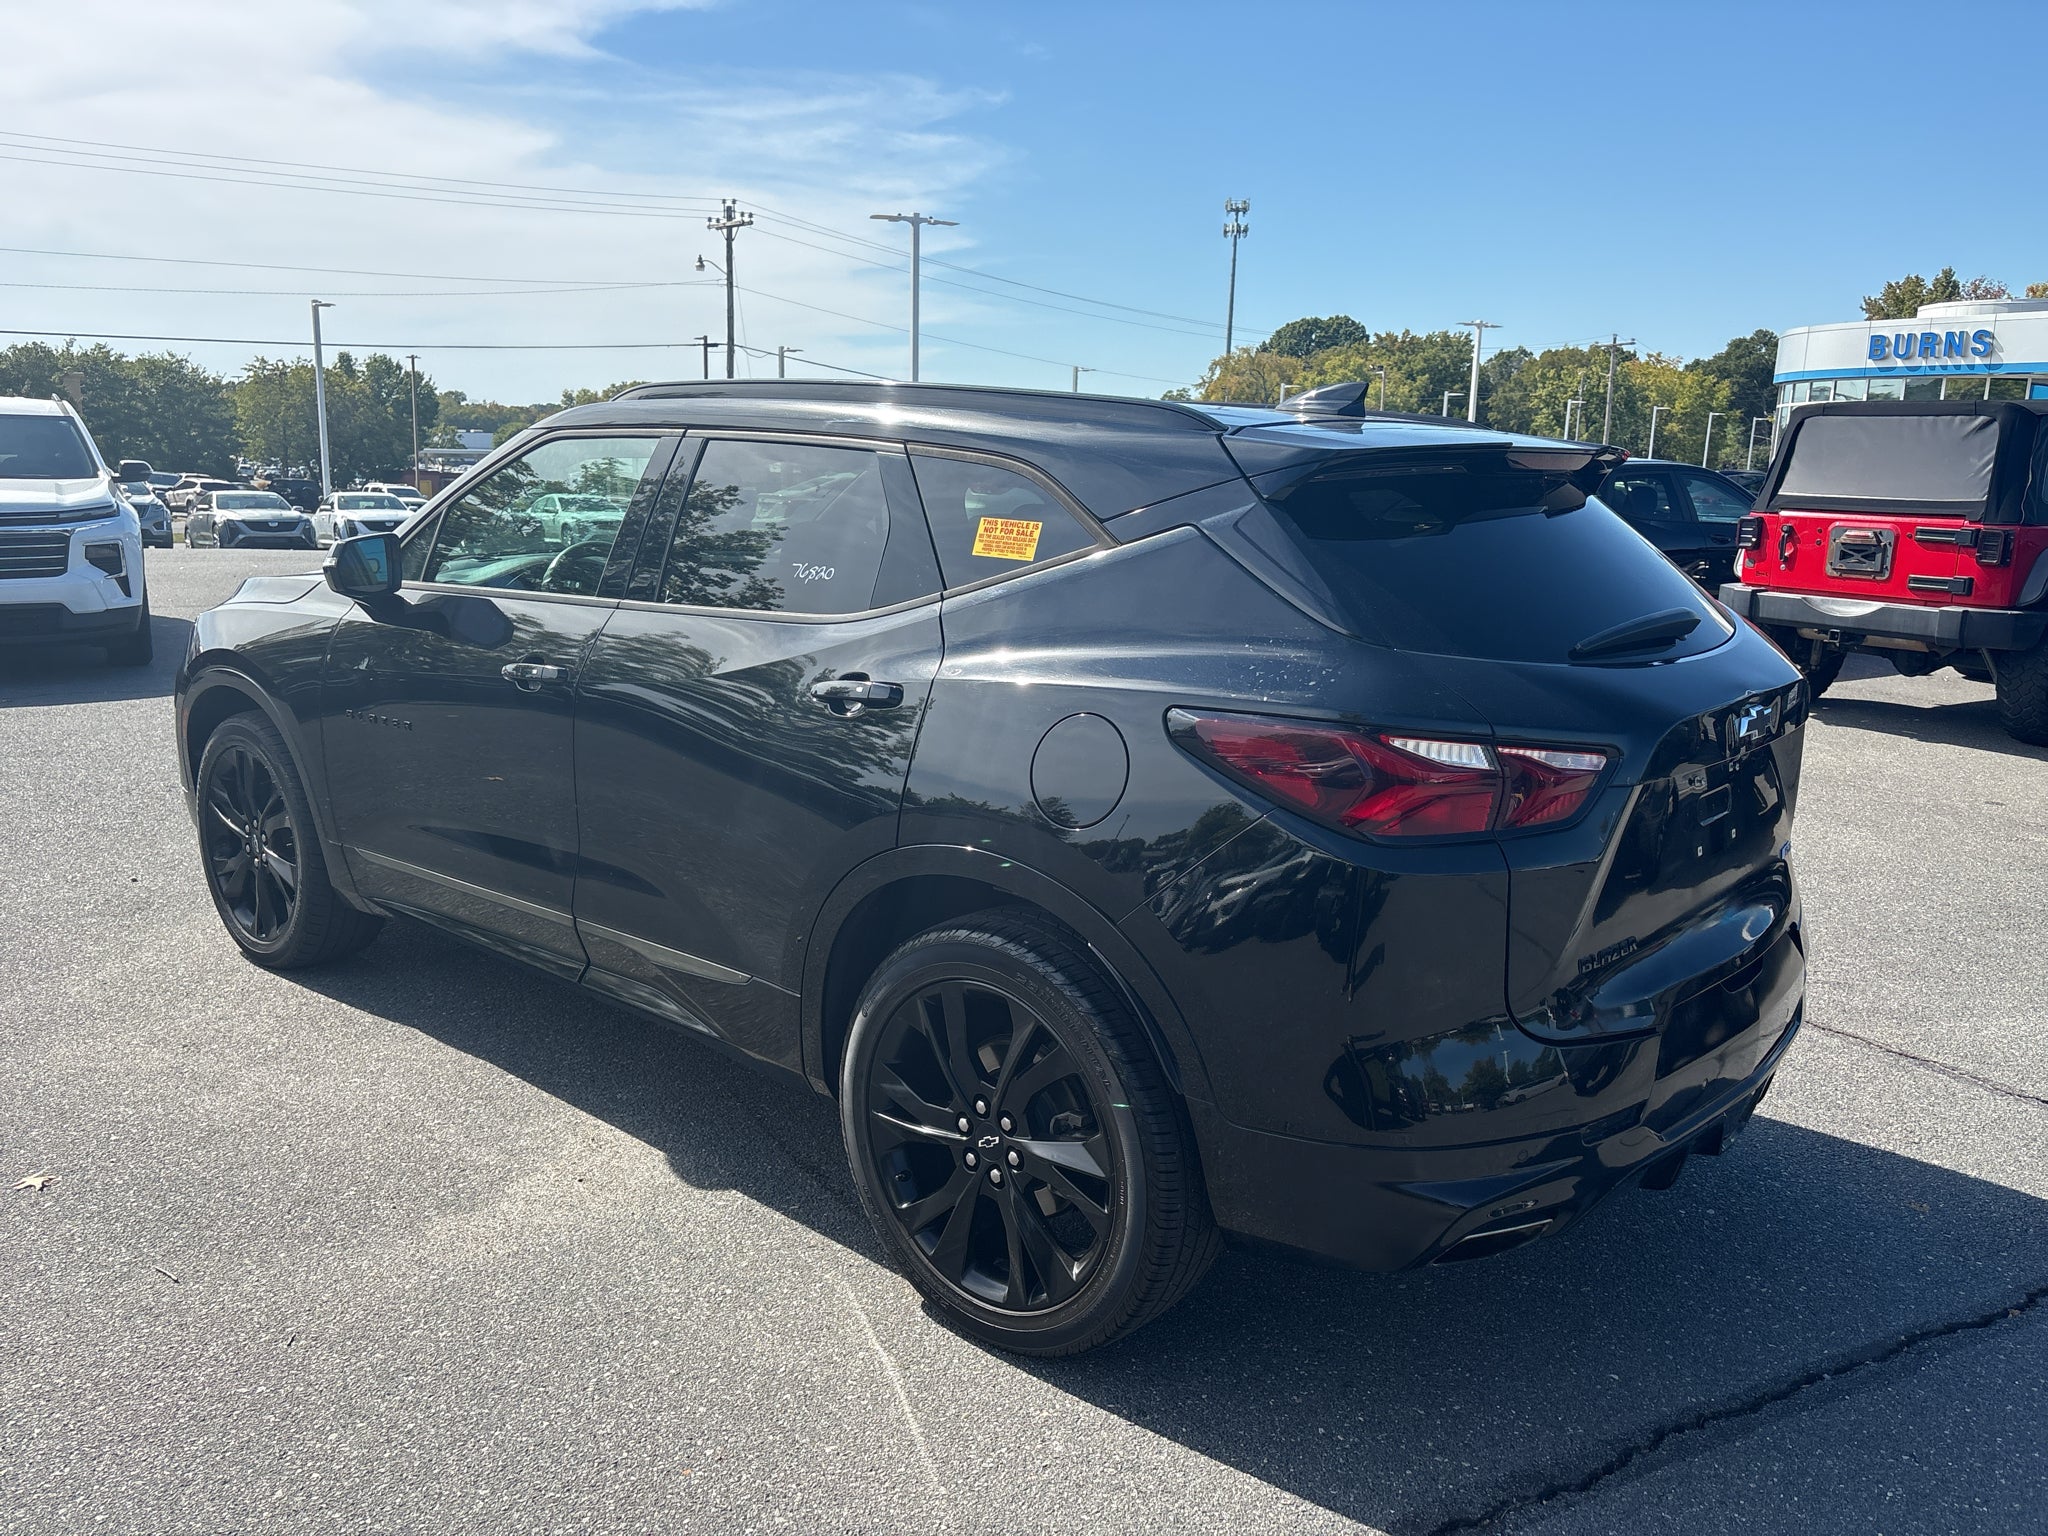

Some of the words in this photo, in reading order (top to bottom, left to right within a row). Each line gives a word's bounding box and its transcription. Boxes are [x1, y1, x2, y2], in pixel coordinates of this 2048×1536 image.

[1868, 329, 1993, 360] BURNS
[982, 519, 998, 527] THIS
[1000, 520, 1030, 529] VEHICLE
[1031, 523, 1039, 531] IS
[983, 526, 998, 534] NOT
[1015, 529, 1035, 537] SALE
[792, 562, 835, 584] 76820
